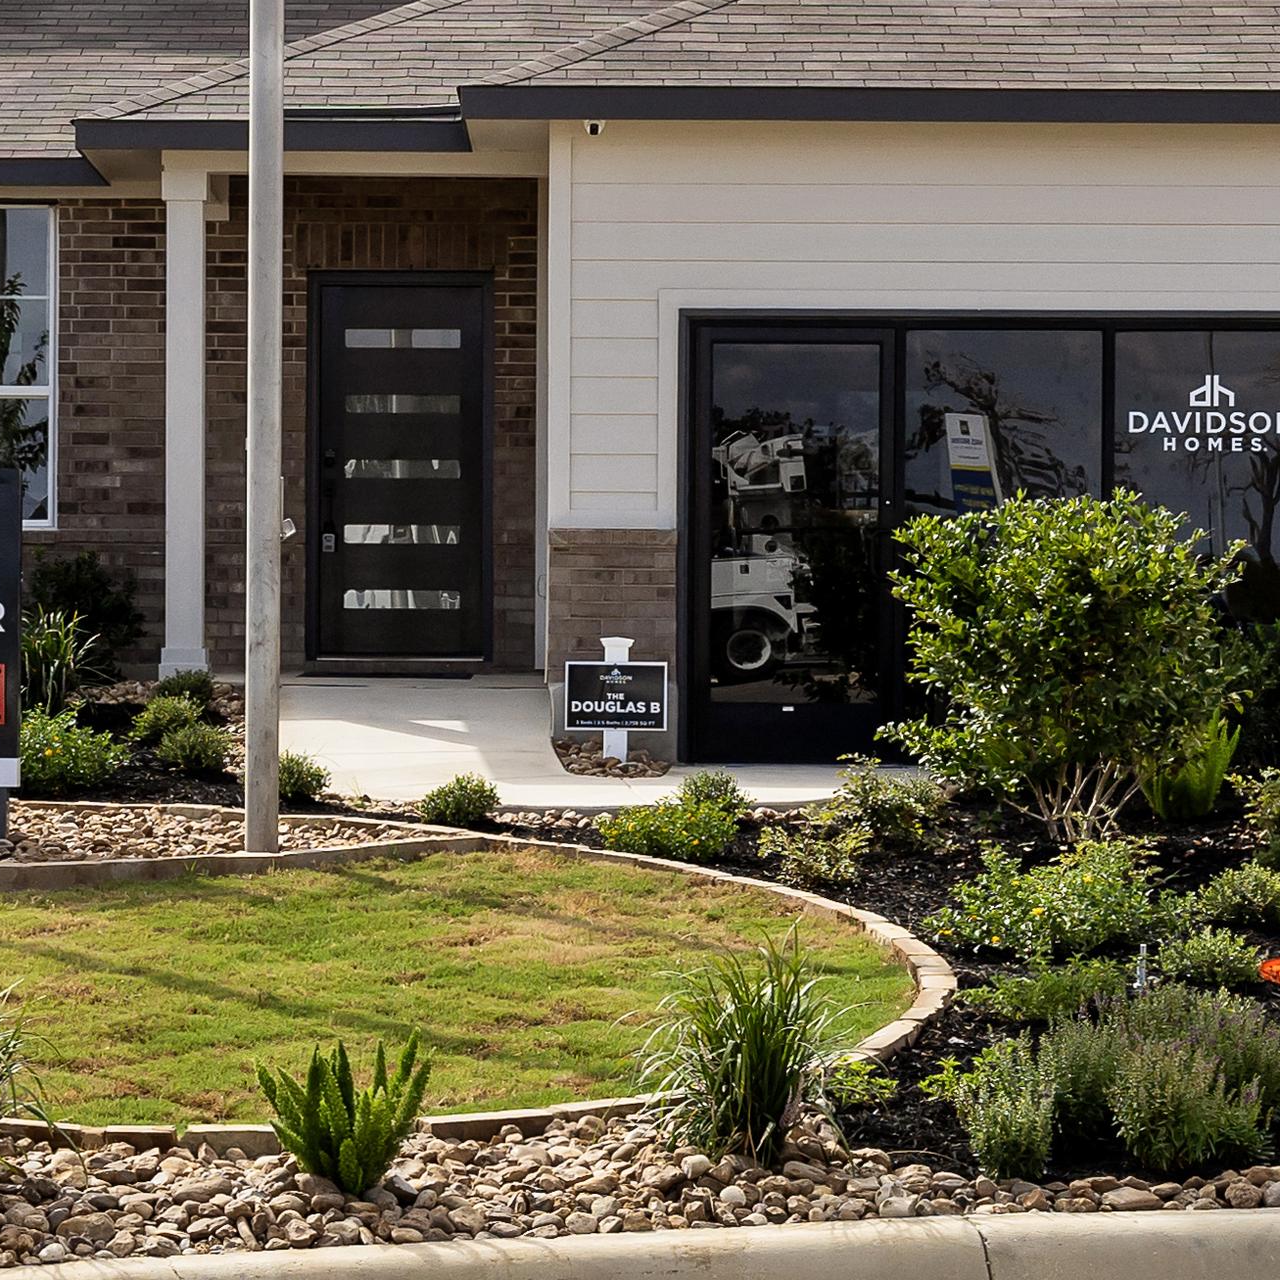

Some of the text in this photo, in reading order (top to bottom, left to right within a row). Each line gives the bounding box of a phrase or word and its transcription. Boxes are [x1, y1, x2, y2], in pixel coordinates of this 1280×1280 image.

[606, 692, 625, 700] THE
[571, 701, 661, 714] DOUGLAS B
